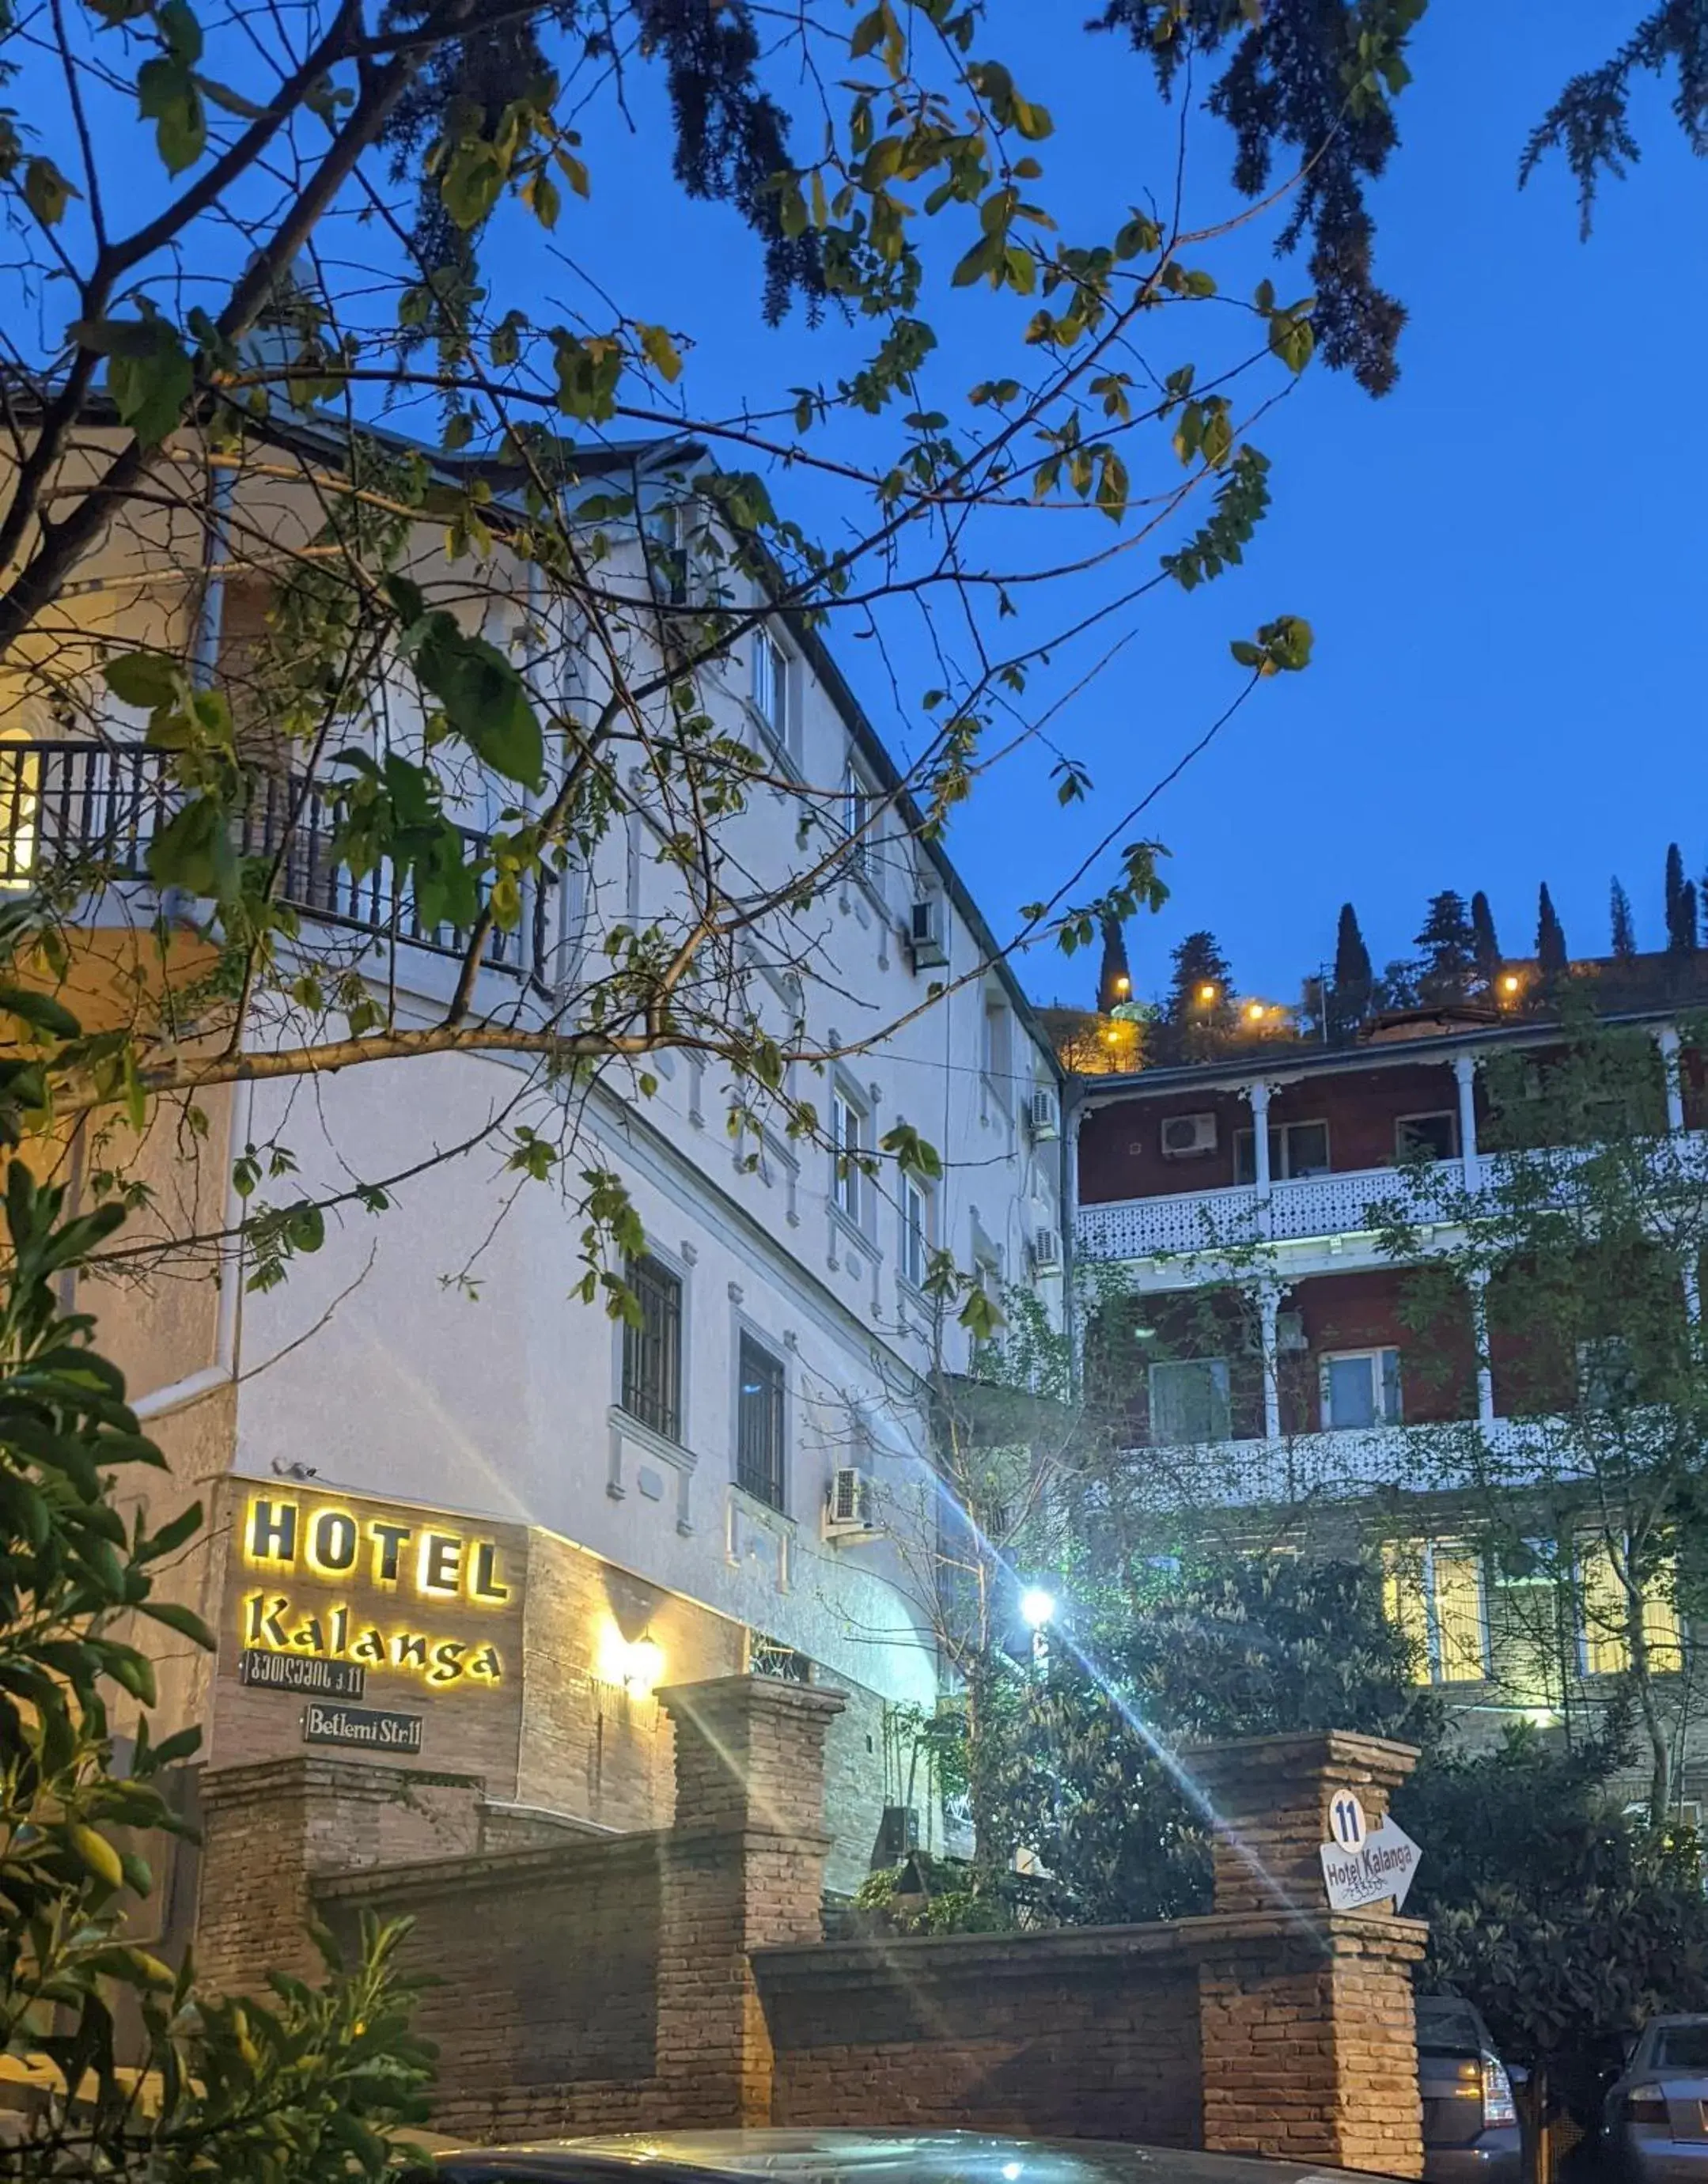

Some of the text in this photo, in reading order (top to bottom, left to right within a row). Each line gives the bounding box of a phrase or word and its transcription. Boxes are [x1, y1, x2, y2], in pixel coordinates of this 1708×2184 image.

[247, 1497, 510, 1601] HOTEL
[309, 1708, 377, 1741] Betlemi
[1335, 1800, 1360, 1843] 11
[1326, 1844, 1412, 1887] Hotel Kalanga
